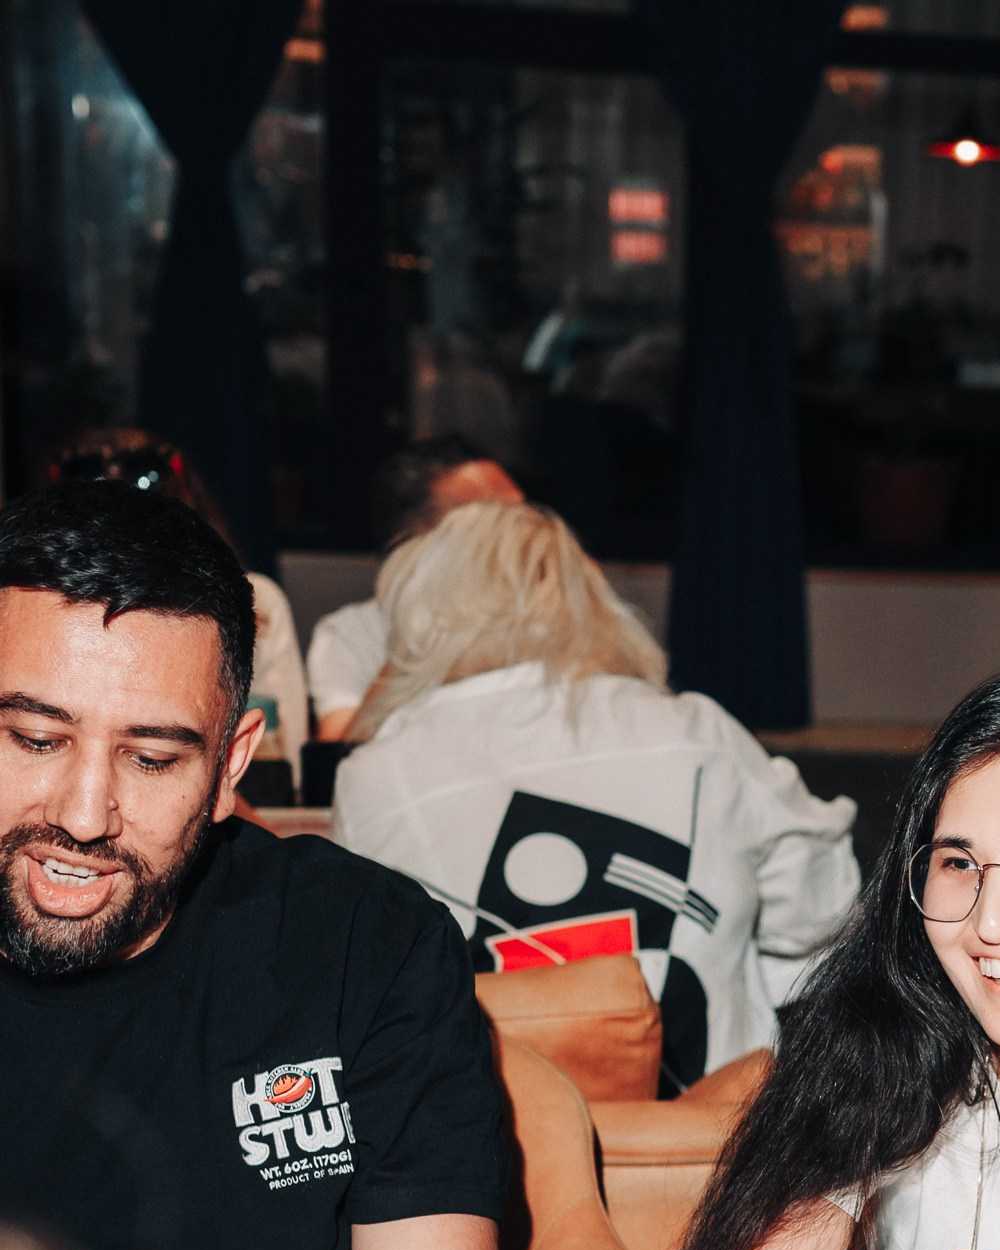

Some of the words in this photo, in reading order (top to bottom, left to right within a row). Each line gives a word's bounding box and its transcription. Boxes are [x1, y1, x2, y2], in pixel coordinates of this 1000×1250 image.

[269, 1172, 310, 1190] PRODUCT
[313, 1169, 325, 1179] OF
[328, 1163, 355, 1176] SPAIN
